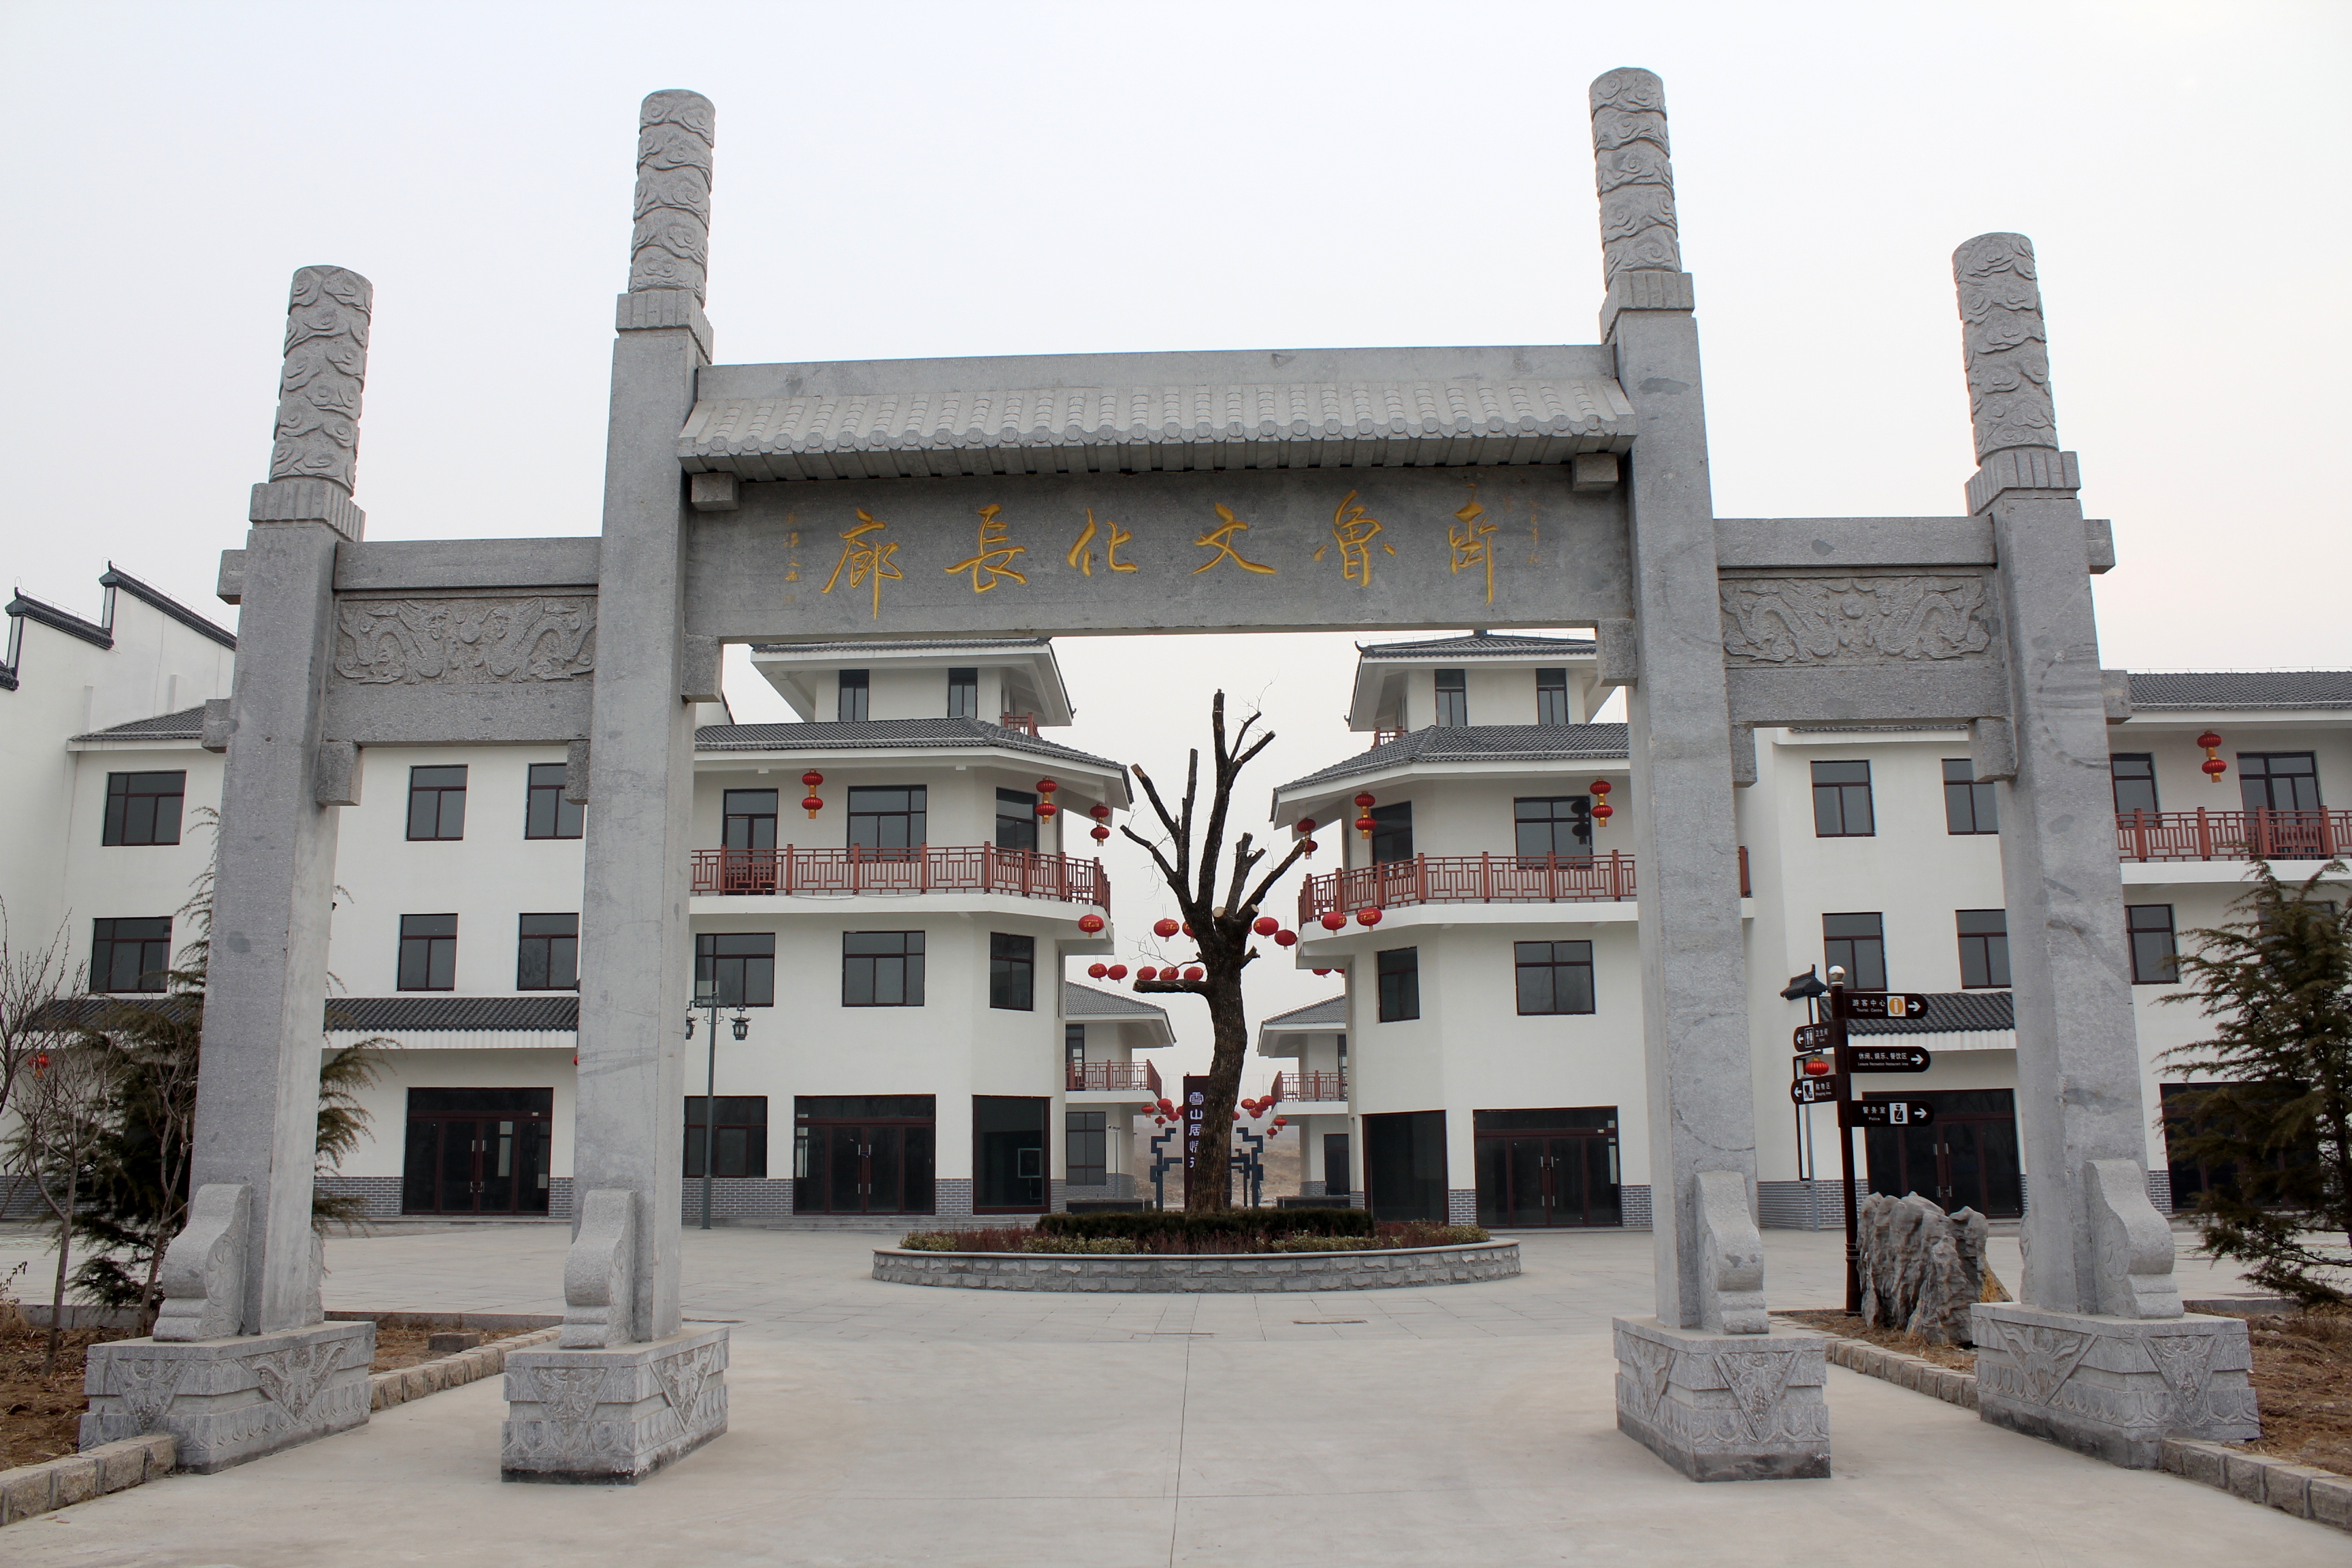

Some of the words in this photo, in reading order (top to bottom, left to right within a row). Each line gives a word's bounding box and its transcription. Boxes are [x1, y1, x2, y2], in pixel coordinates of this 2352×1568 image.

[1815, 1028, 1829, 1037] 卫生间
[1863, 1106, 1886, 1114] 警务室
